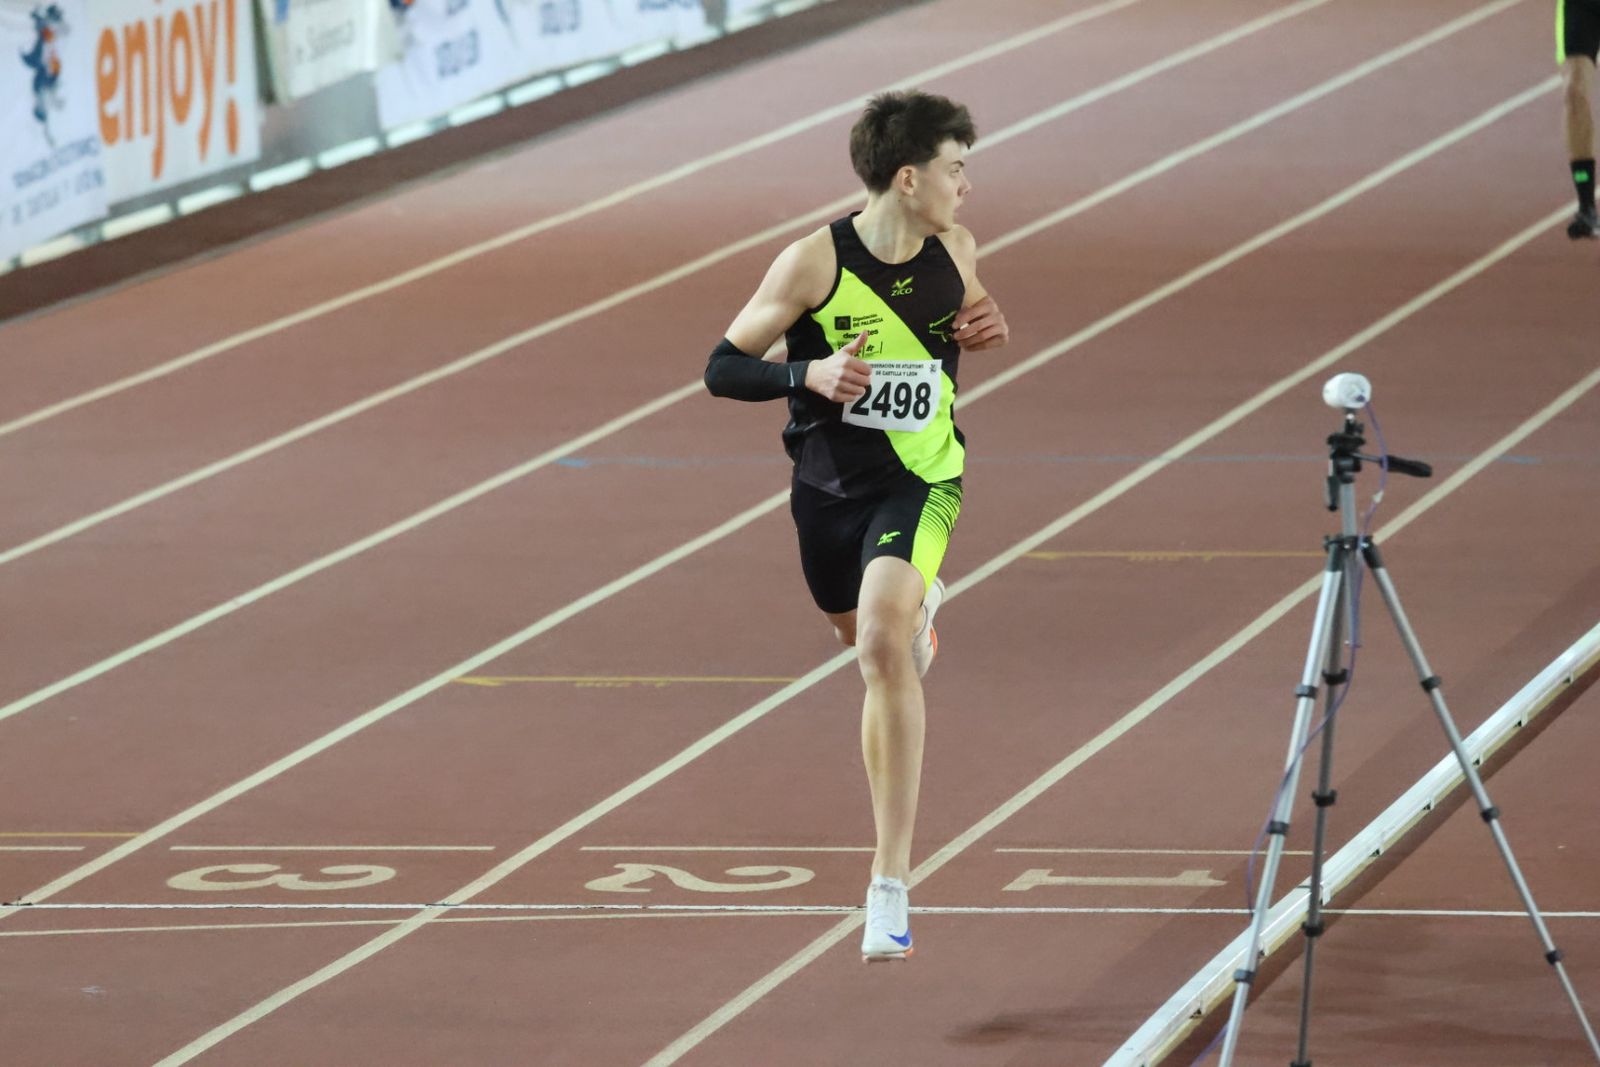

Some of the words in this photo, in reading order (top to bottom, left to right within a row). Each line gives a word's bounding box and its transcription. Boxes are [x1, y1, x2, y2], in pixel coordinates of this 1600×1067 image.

[95, 0, 239, 180] enjoy!
[890, 287, 913, 297] ZICO
[850, 381, 931, 420] 2498
[166, 863, 396, 891] 3
[585, 863, 815, 892] 2
